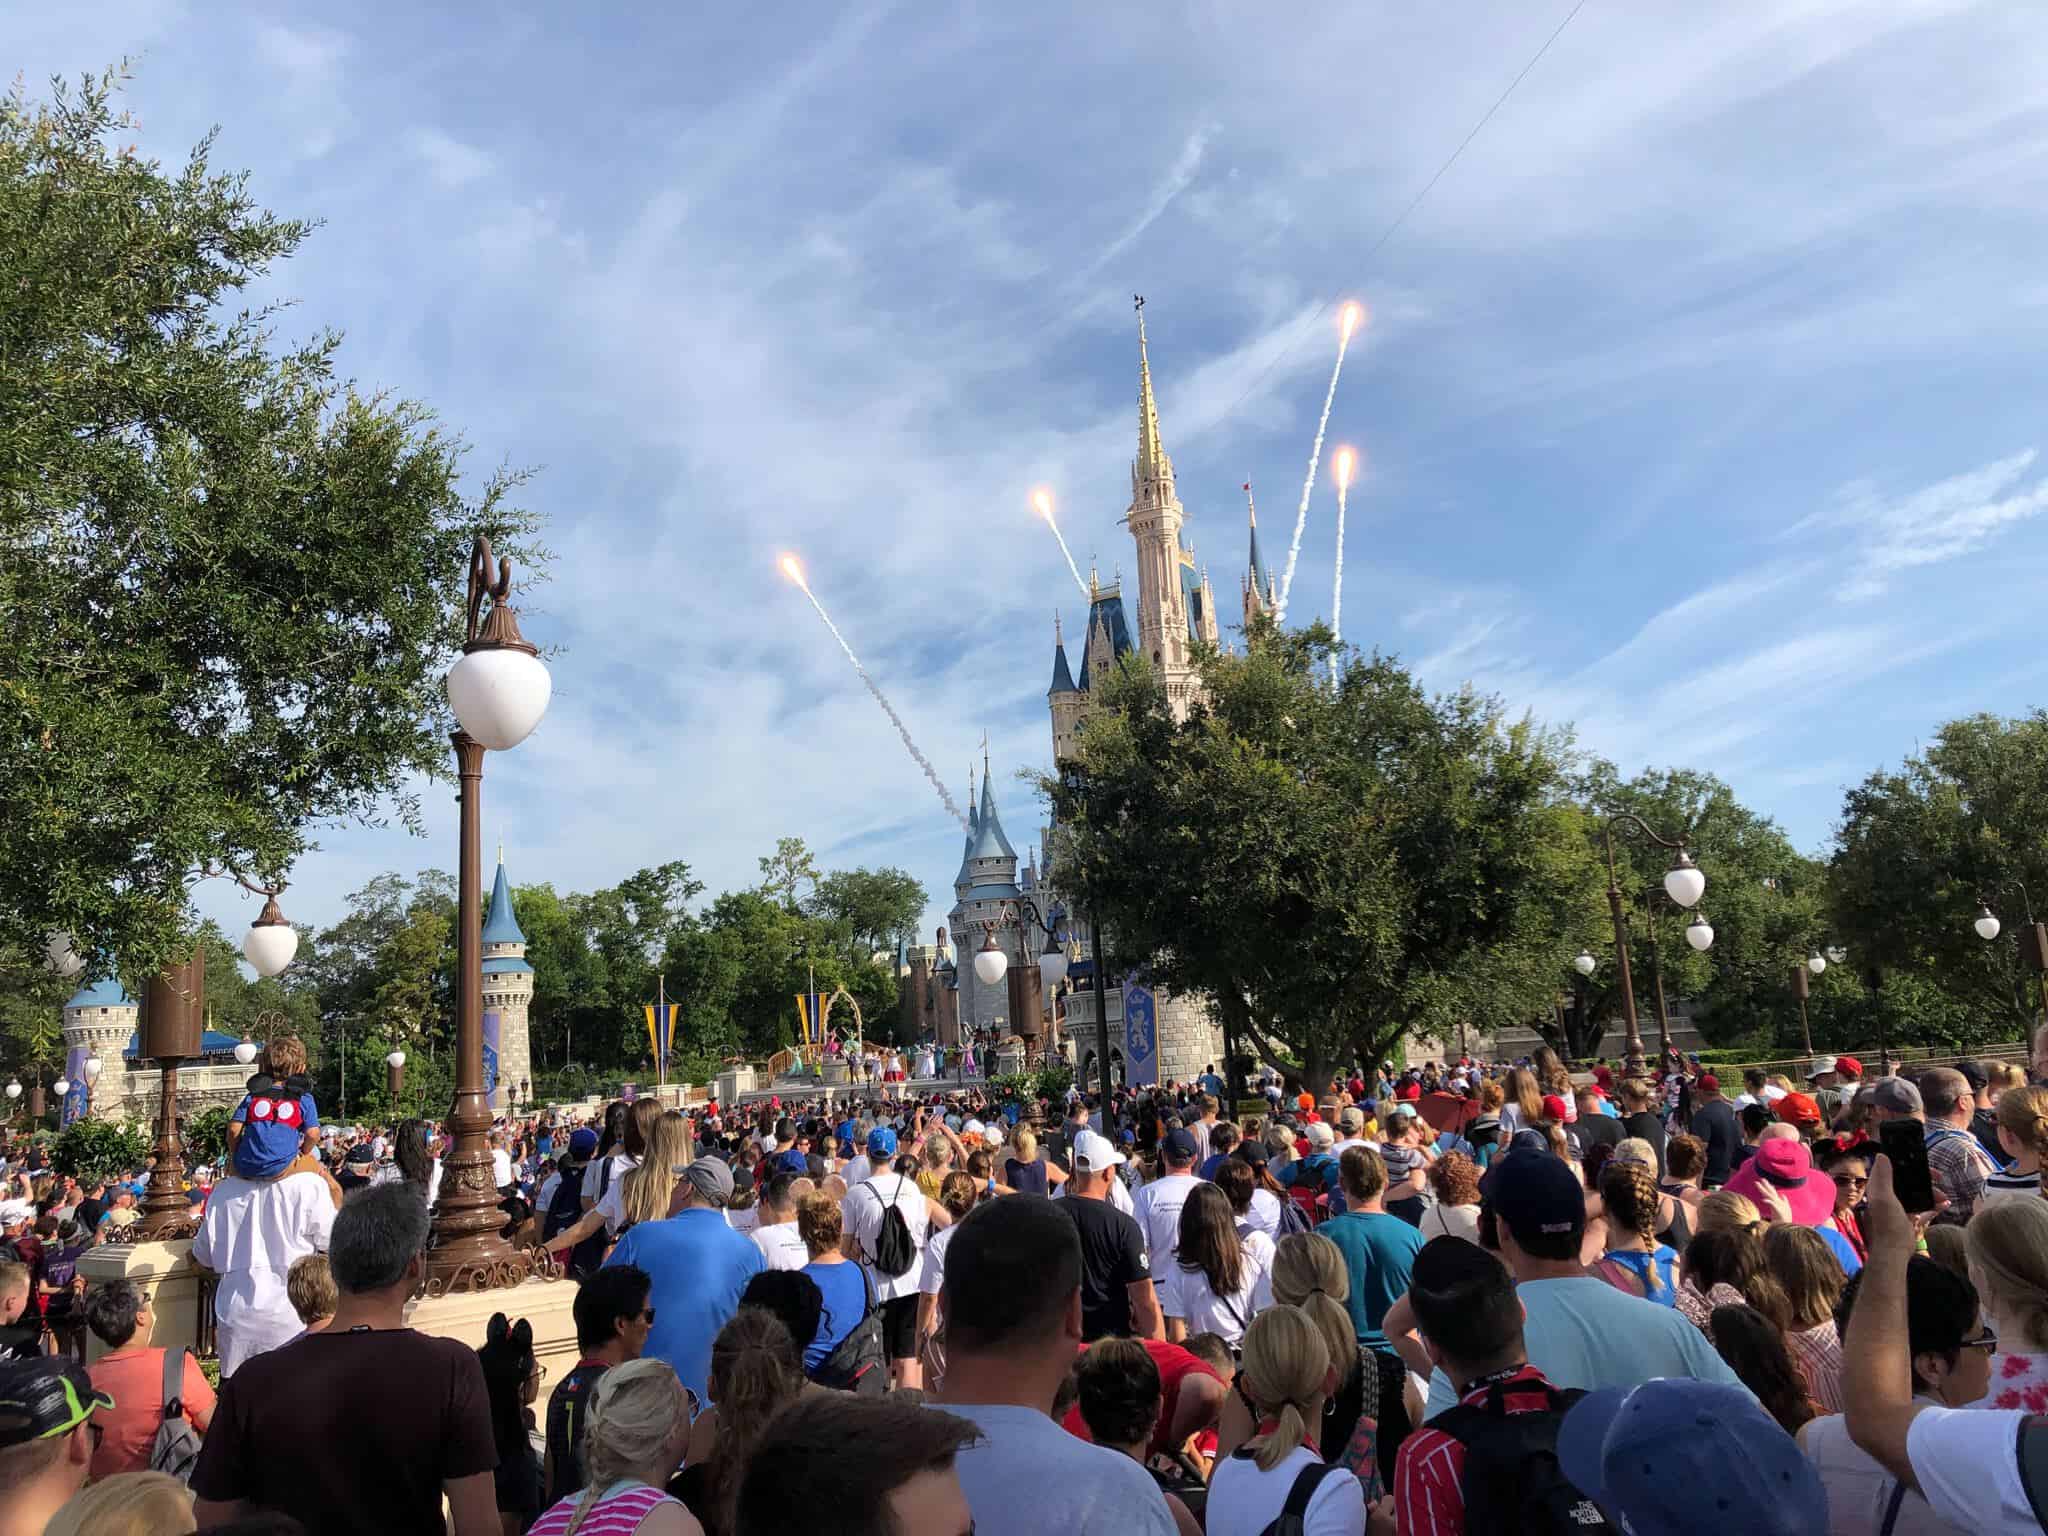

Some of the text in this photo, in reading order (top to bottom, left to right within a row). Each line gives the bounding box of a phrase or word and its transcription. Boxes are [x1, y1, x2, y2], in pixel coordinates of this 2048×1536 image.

[1576, 1500, 1593, 1510] THE
[1568, 1509, 1594, 1518] NORTH
[1577, 1516, 1597, 1525] FACE
